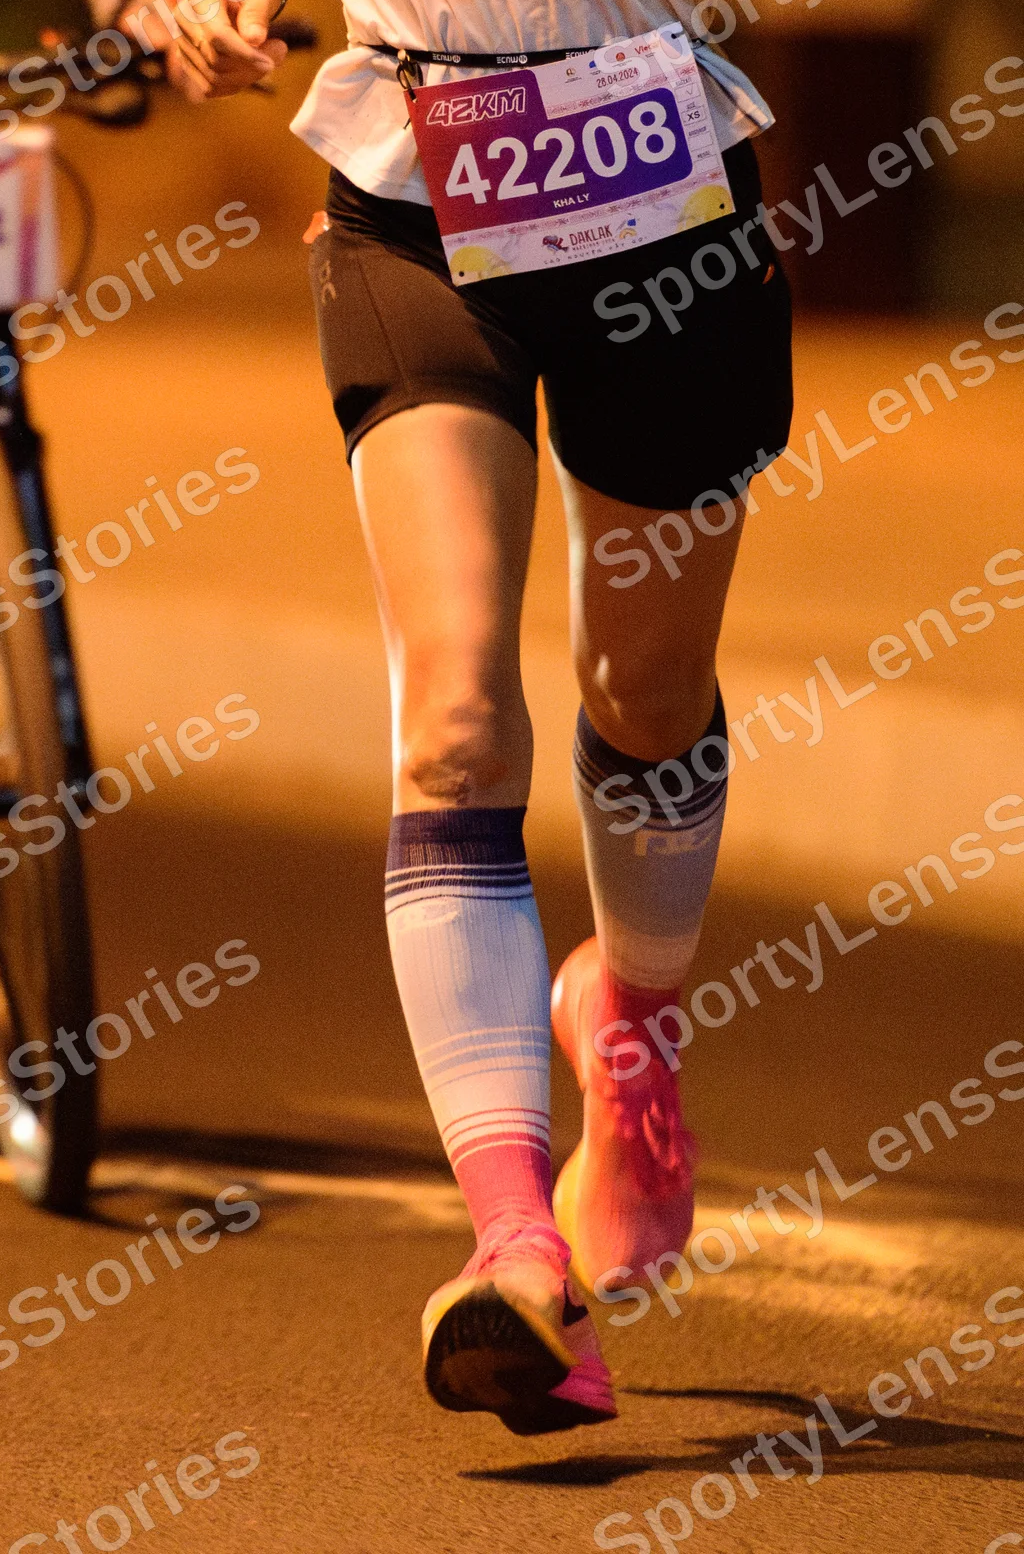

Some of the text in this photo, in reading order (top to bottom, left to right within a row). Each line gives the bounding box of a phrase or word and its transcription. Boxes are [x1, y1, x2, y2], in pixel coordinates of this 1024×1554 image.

[596, 67, 639, 88] 28.04.2024
[426, 87, 526, 126] 42KM
[687, 110, 701, 122] XS
[445, 100, 676, 204] 42208
[553, 193, 590, 208] KHA LY
[569, 225, 613, 246] DAKLAK
